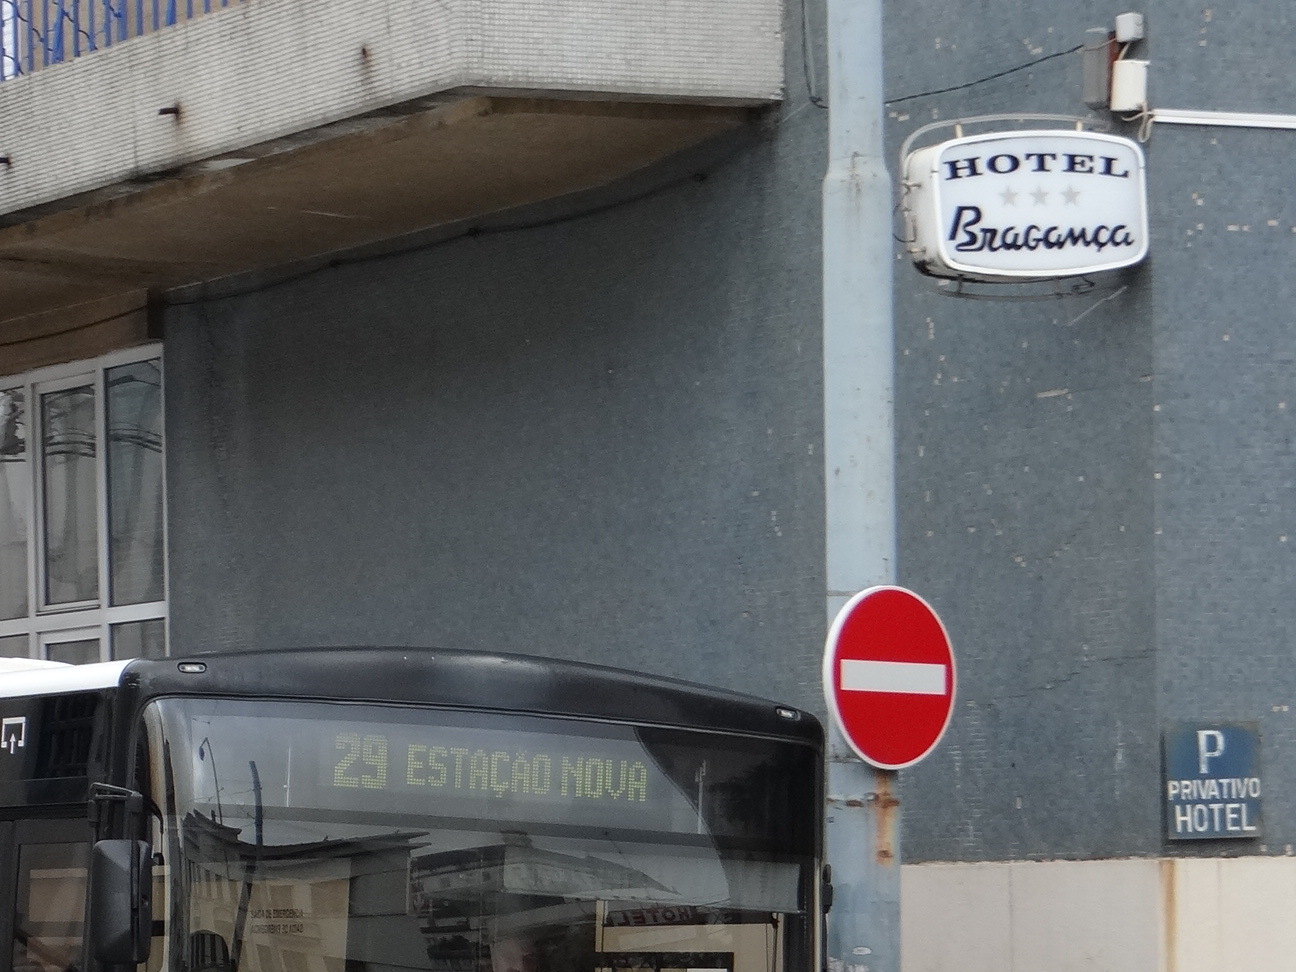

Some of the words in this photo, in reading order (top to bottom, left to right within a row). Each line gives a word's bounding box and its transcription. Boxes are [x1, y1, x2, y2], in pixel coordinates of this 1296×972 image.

[943, 152, 1130, 181] HOTEL
[947, 205, 1135, 254] Bragança
[332, 731, 389, 790] 29
[560, 754, 649, 802] NOVA
[1196, 729, 1225, 774] P
[1167, 777, 1262, 801] PRIVATIVO
[1174, 802, 1257, 833] HOTEL
